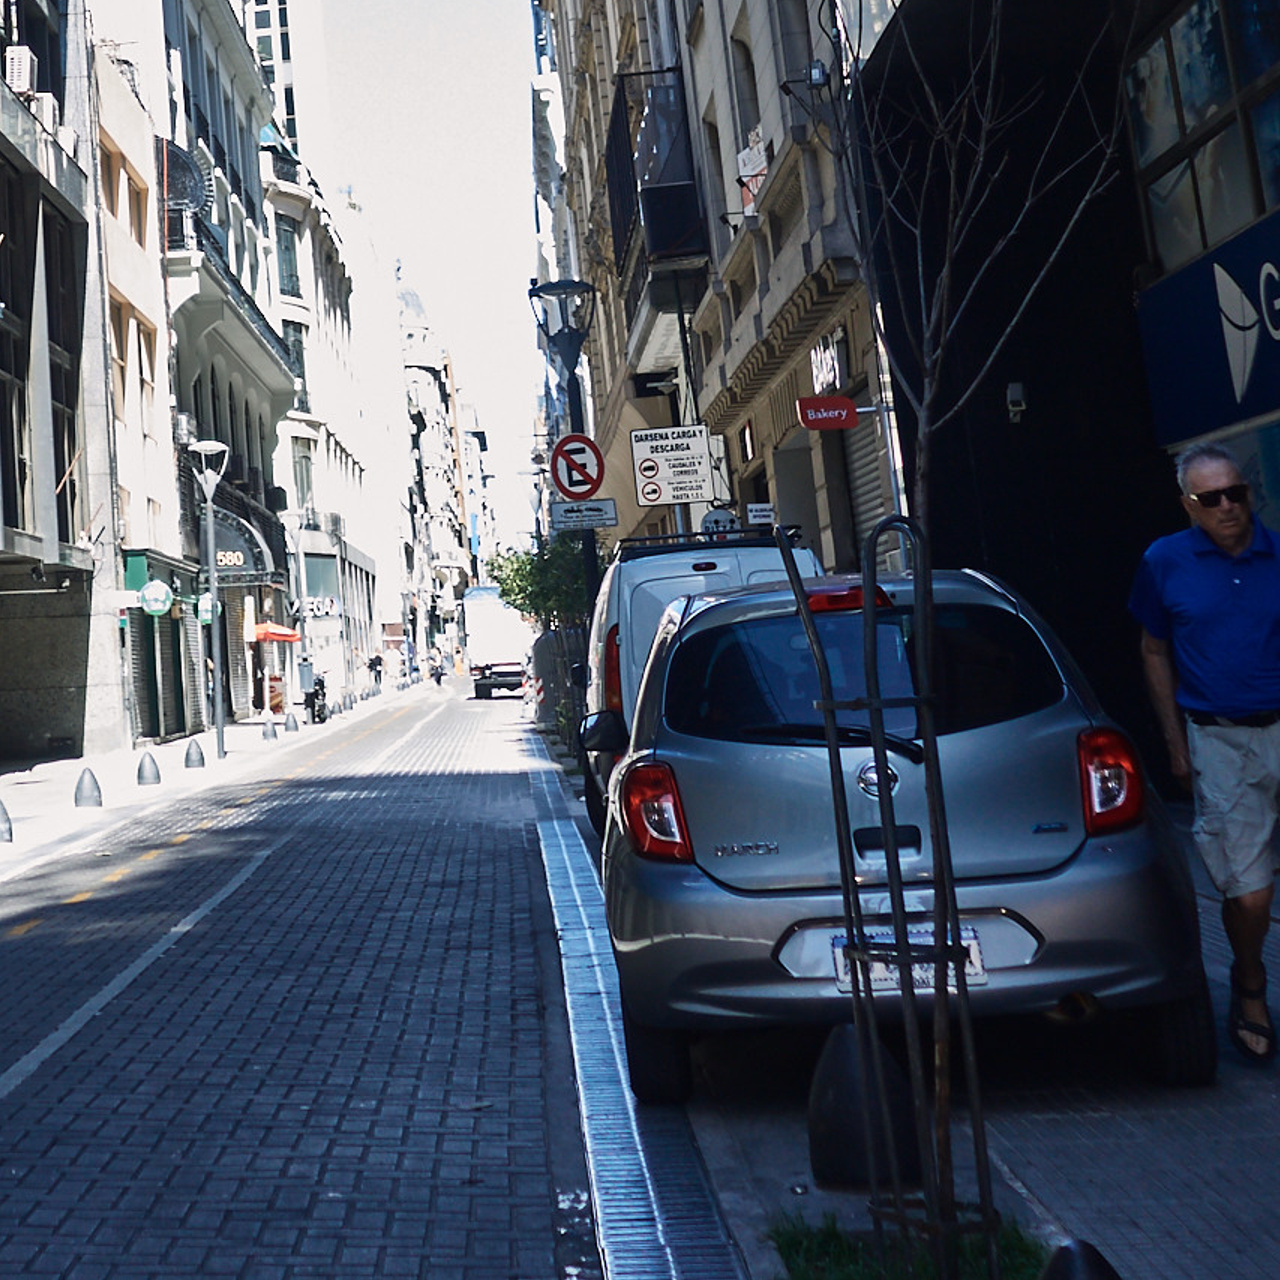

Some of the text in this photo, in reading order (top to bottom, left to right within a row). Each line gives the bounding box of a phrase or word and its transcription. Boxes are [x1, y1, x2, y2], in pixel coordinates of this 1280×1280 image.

[806, 408, 847, 420] Bakery
[634, 429, 704, 443] DARSENA CARGA Y
[649, 443, 691, 454] DESCARGA
[216, 551, 244, 566] 580
